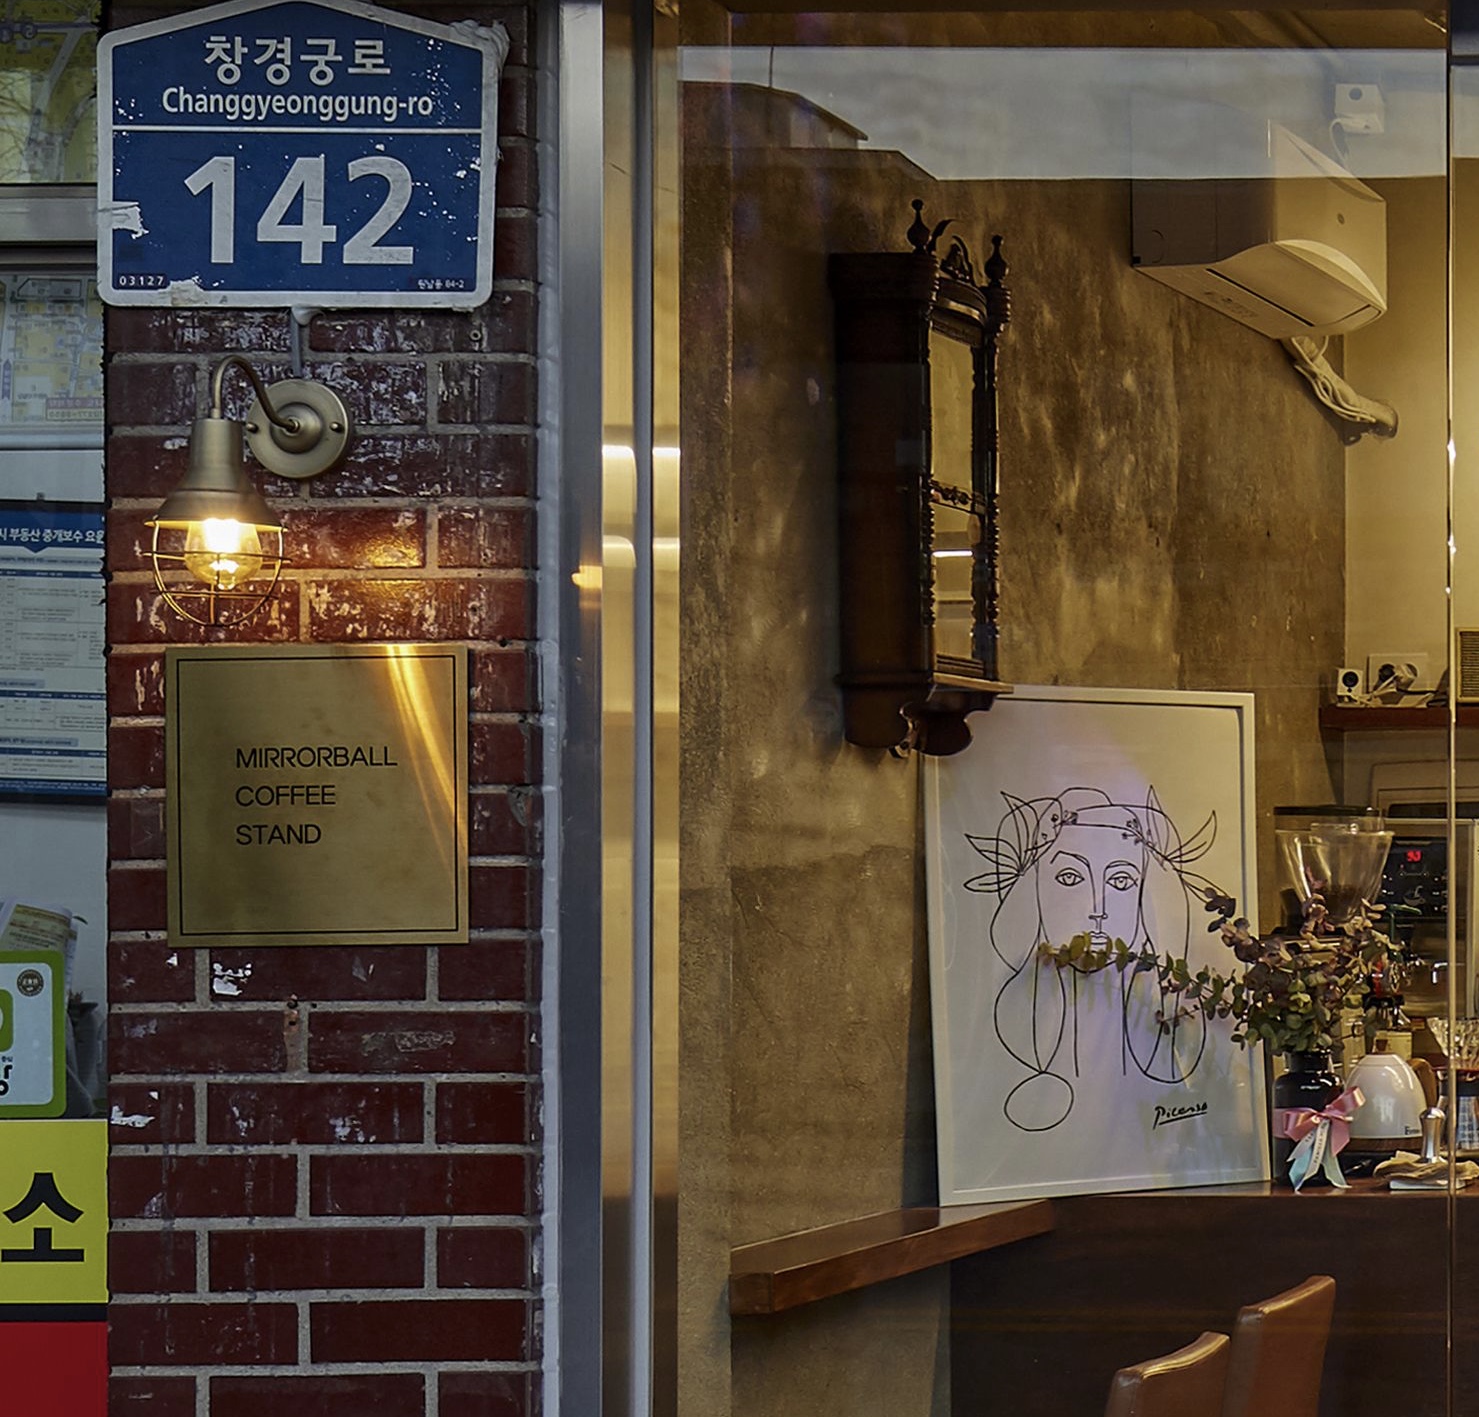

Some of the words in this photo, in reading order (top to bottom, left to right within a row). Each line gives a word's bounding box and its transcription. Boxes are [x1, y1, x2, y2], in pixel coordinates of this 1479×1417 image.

[204, 34, 391, 86] 창경궁로
[162, 87, 434, 122] Changgyeonggung-ro
[184, 155, 414, 265] 142
[119, 275, 165, 286] 03127
[9, 527, 41, 543] 부동산
[42, 528, 84, 545] 중개보수
[235, 745, 398, 769] MIRRORBALL
[235, 784, 336, 808] COFFEE
[235, 823, 322, 847] STAND
[1, 1172, 84, 1263] 소
